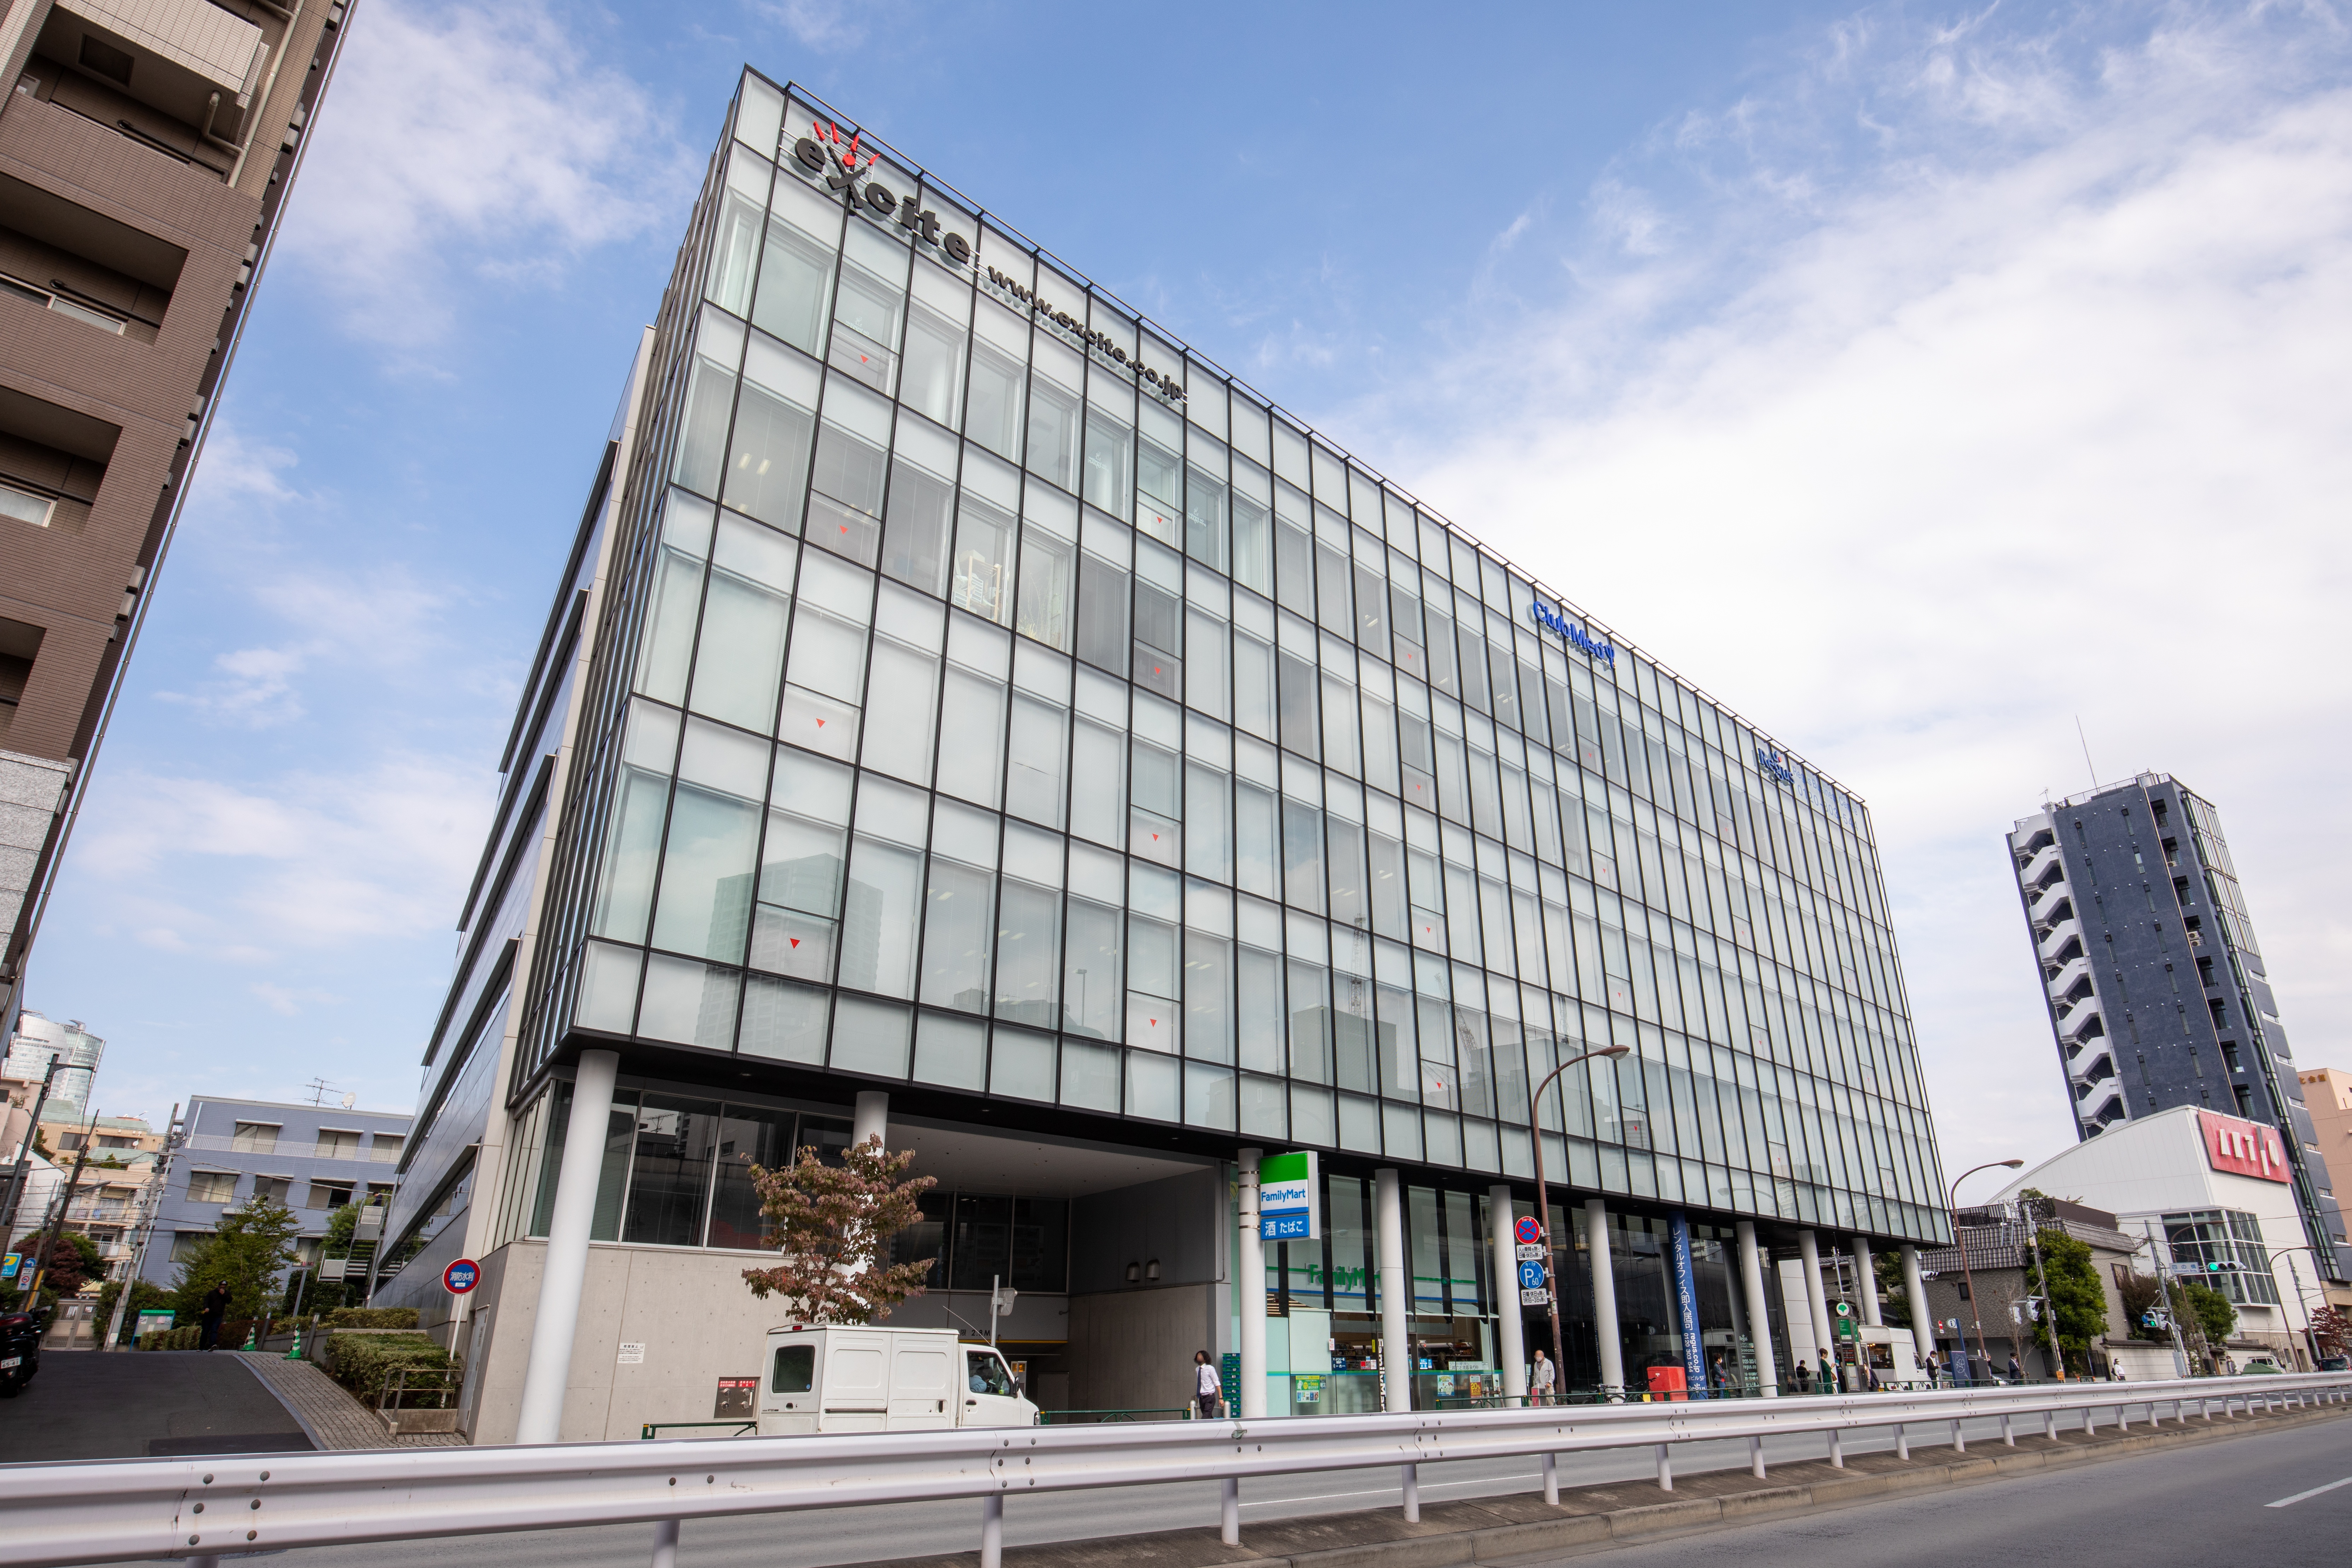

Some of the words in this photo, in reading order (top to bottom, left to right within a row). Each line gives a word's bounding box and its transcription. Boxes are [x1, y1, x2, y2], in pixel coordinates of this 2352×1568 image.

[794, 134, 971, 264] excite
[987, 264, 1184, 402] www.excite.co.jp
[1757, 747, 1795, 785] Regus
[2219, 1126, 2280, 1176] AKTIO
[1261, 1188, 1306, 1202] FamilyMart
[1265, 1221, 1276, 1236] 酒
[1280, 1221, 1304, 1234] たばこ
[450, 1271, 474, 1281] 消防水利
[1524, 1268, 1534, 1286] P
[1532, 1277, 1539, 1286] 60
[1673, 1227, 1693, 1331] レンタルオフィス即入居可
[1690, 1333, 1701, 1373] regus.co.jp
